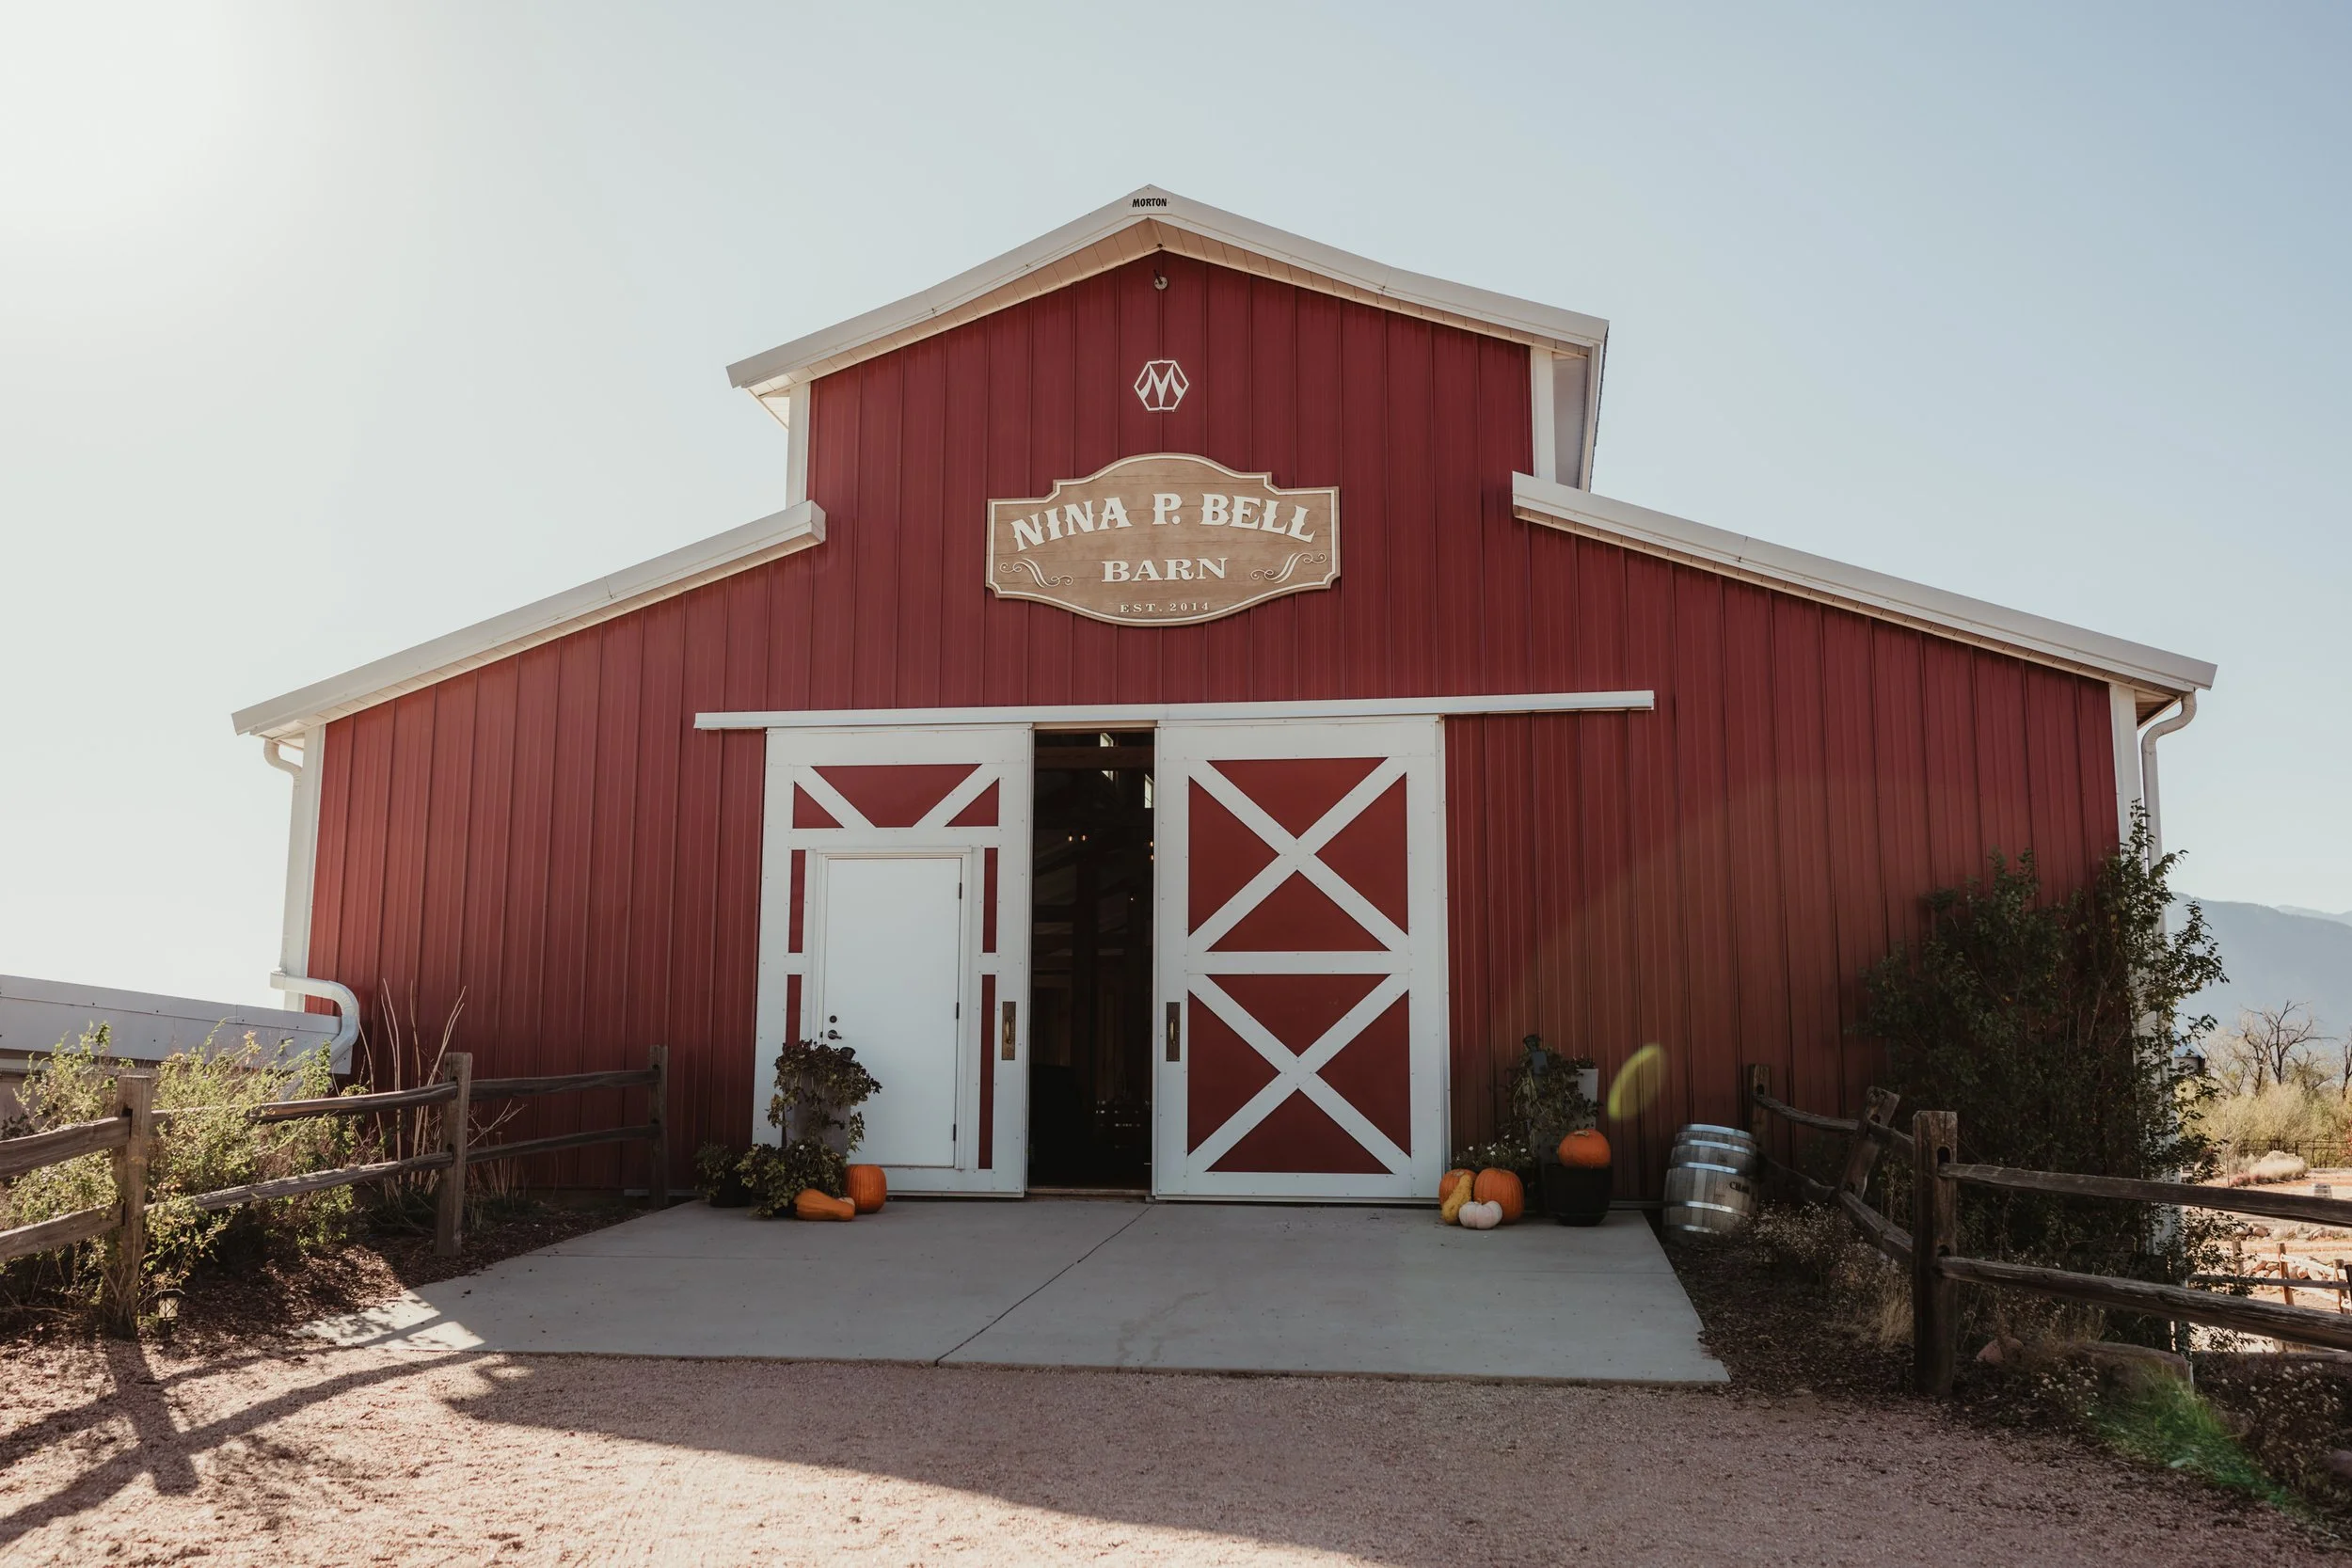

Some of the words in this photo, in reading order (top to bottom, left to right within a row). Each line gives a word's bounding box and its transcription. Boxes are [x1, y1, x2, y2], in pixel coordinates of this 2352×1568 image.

[1132, 198, 1168, 208] MORTON
[1010, 497, 1133, 552] NINA
[1152, 493, 1183, 526] P.
[1199, 493, 1316, 543] BELL
[1101, 558, 1228, 582] BARN
[1120, 604, 1163, 613] EST.
[1169, 602, 1209, 611] 2014
